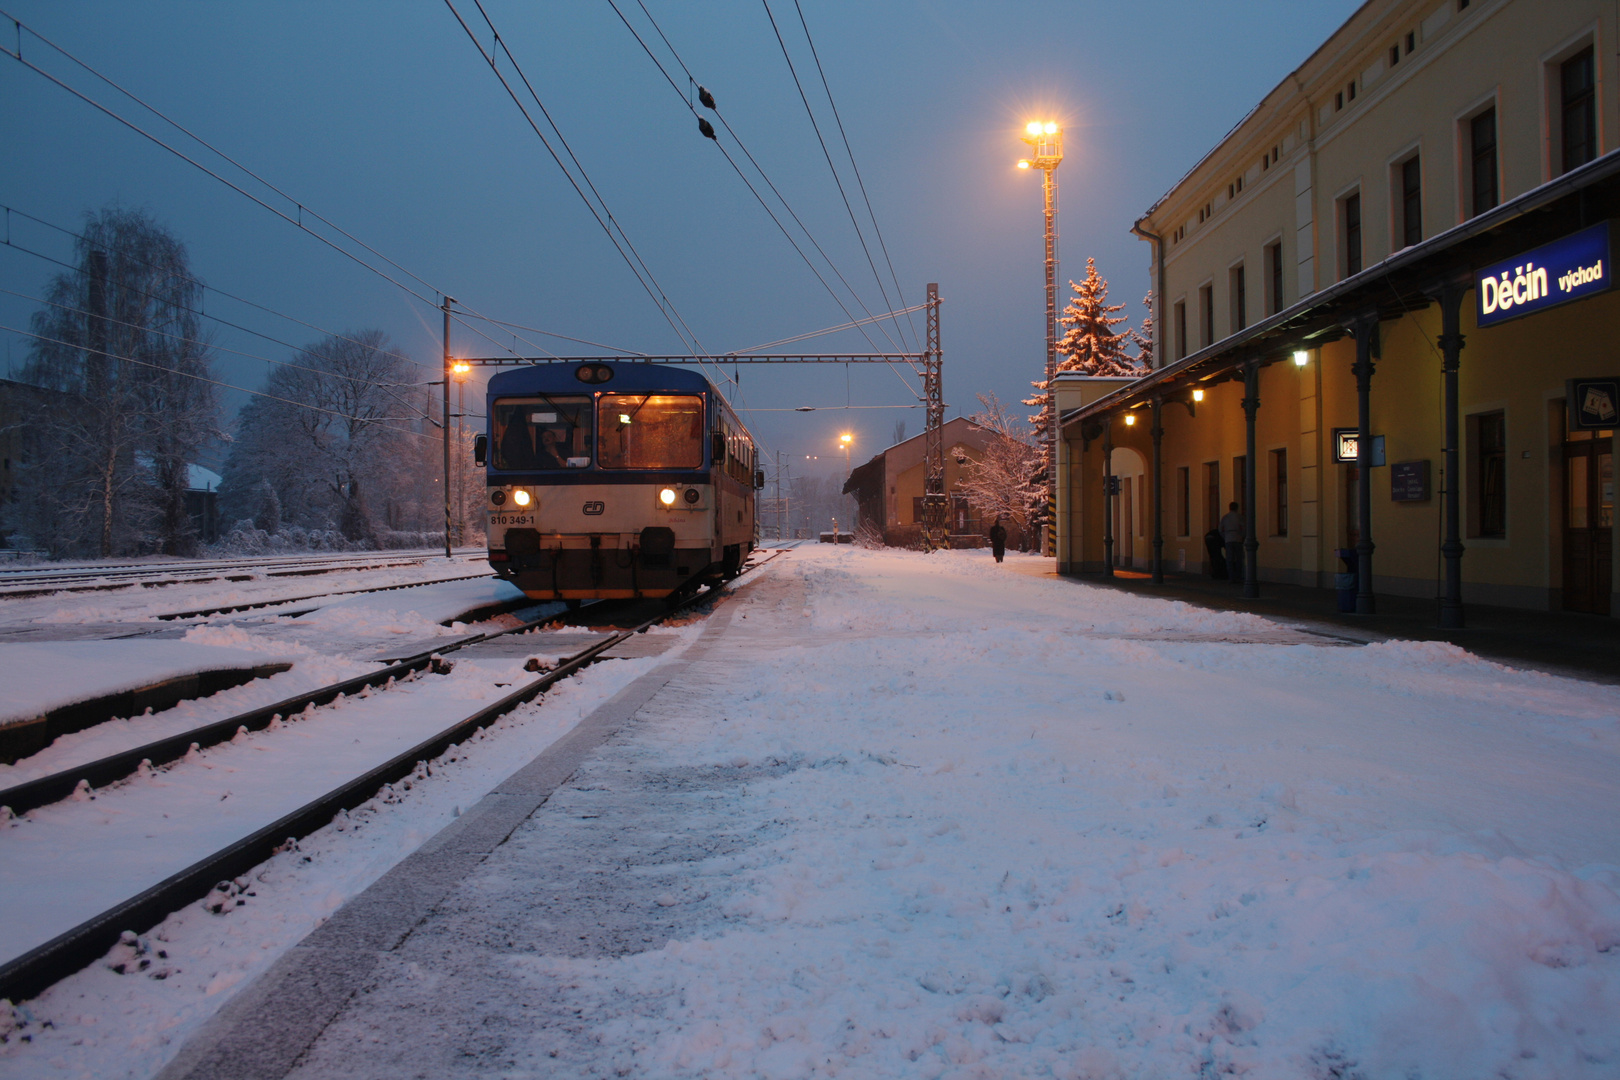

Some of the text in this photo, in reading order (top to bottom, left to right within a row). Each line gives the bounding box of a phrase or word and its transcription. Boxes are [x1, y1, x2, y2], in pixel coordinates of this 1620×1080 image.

[1482, 259, 1603, 315] Děčín východ
[491, 515, 535, 525] 810 349-1
